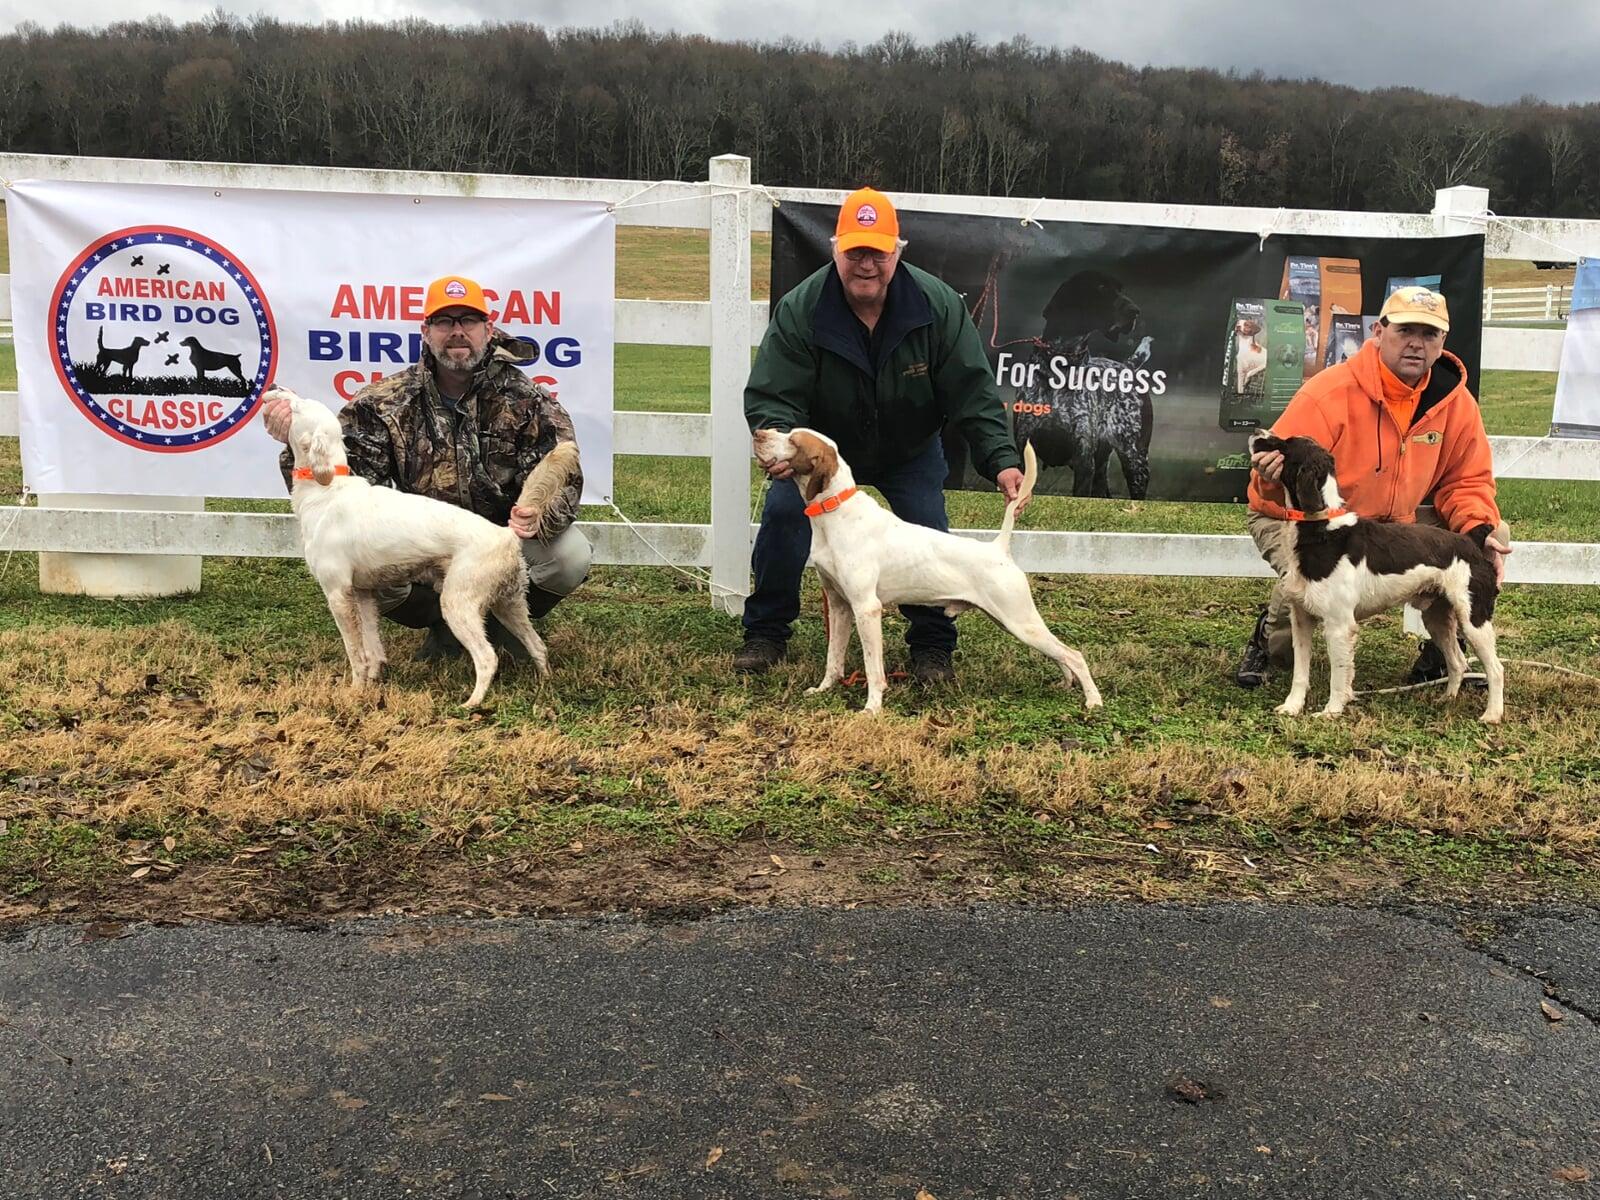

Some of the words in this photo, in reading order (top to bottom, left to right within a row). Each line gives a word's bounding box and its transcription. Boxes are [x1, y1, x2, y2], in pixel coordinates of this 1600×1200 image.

[97, 277, 225, 301] AMERICAN
[85, 302, 162, 322] BIRD
[174, 306, 240, 325] DOG
[330, 284, 561, 325] AMECAN
[996, 352, 1040, 388] For
[1049, 355, 1167, 395] Success
[108, 399, 224, 429] CLASSIC
[1013, 399, 1052, 416] dogs
